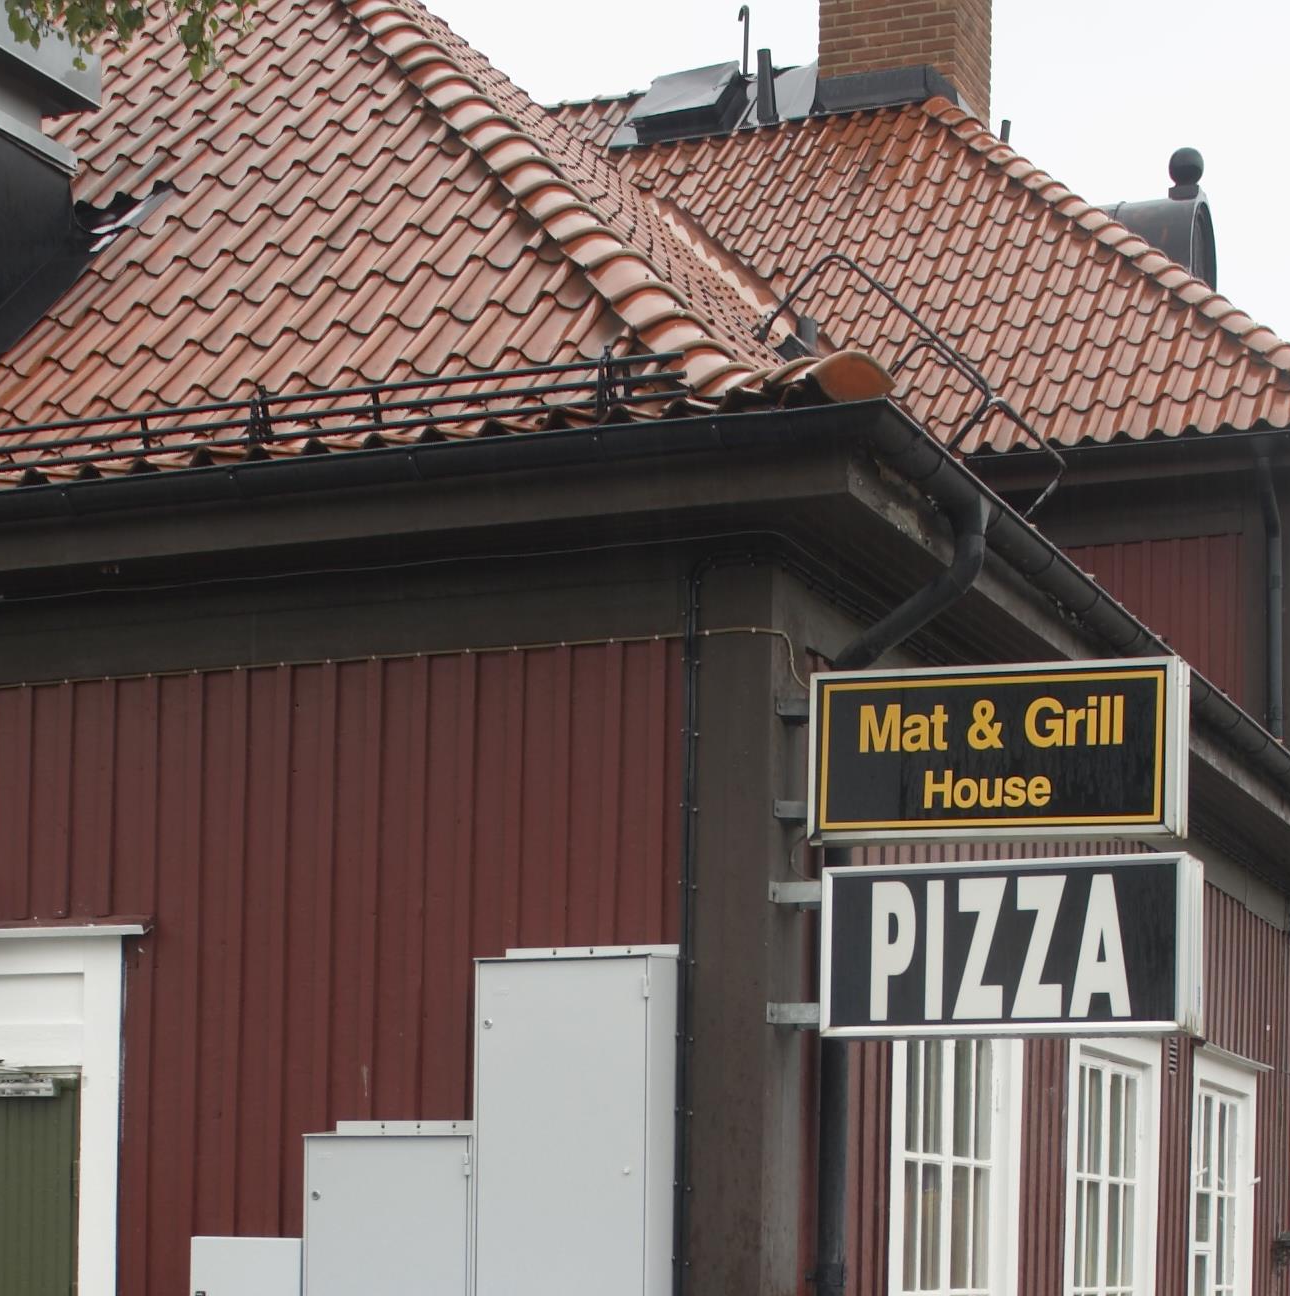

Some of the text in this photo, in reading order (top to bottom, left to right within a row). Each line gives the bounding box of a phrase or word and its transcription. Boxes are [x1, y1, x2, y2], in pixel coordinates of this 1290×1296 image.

[858, 695, 1125, 754] Mat & Grill
[923, 770, 1052, 809] House
[869, 873, 1132, 1022] PIZZA
